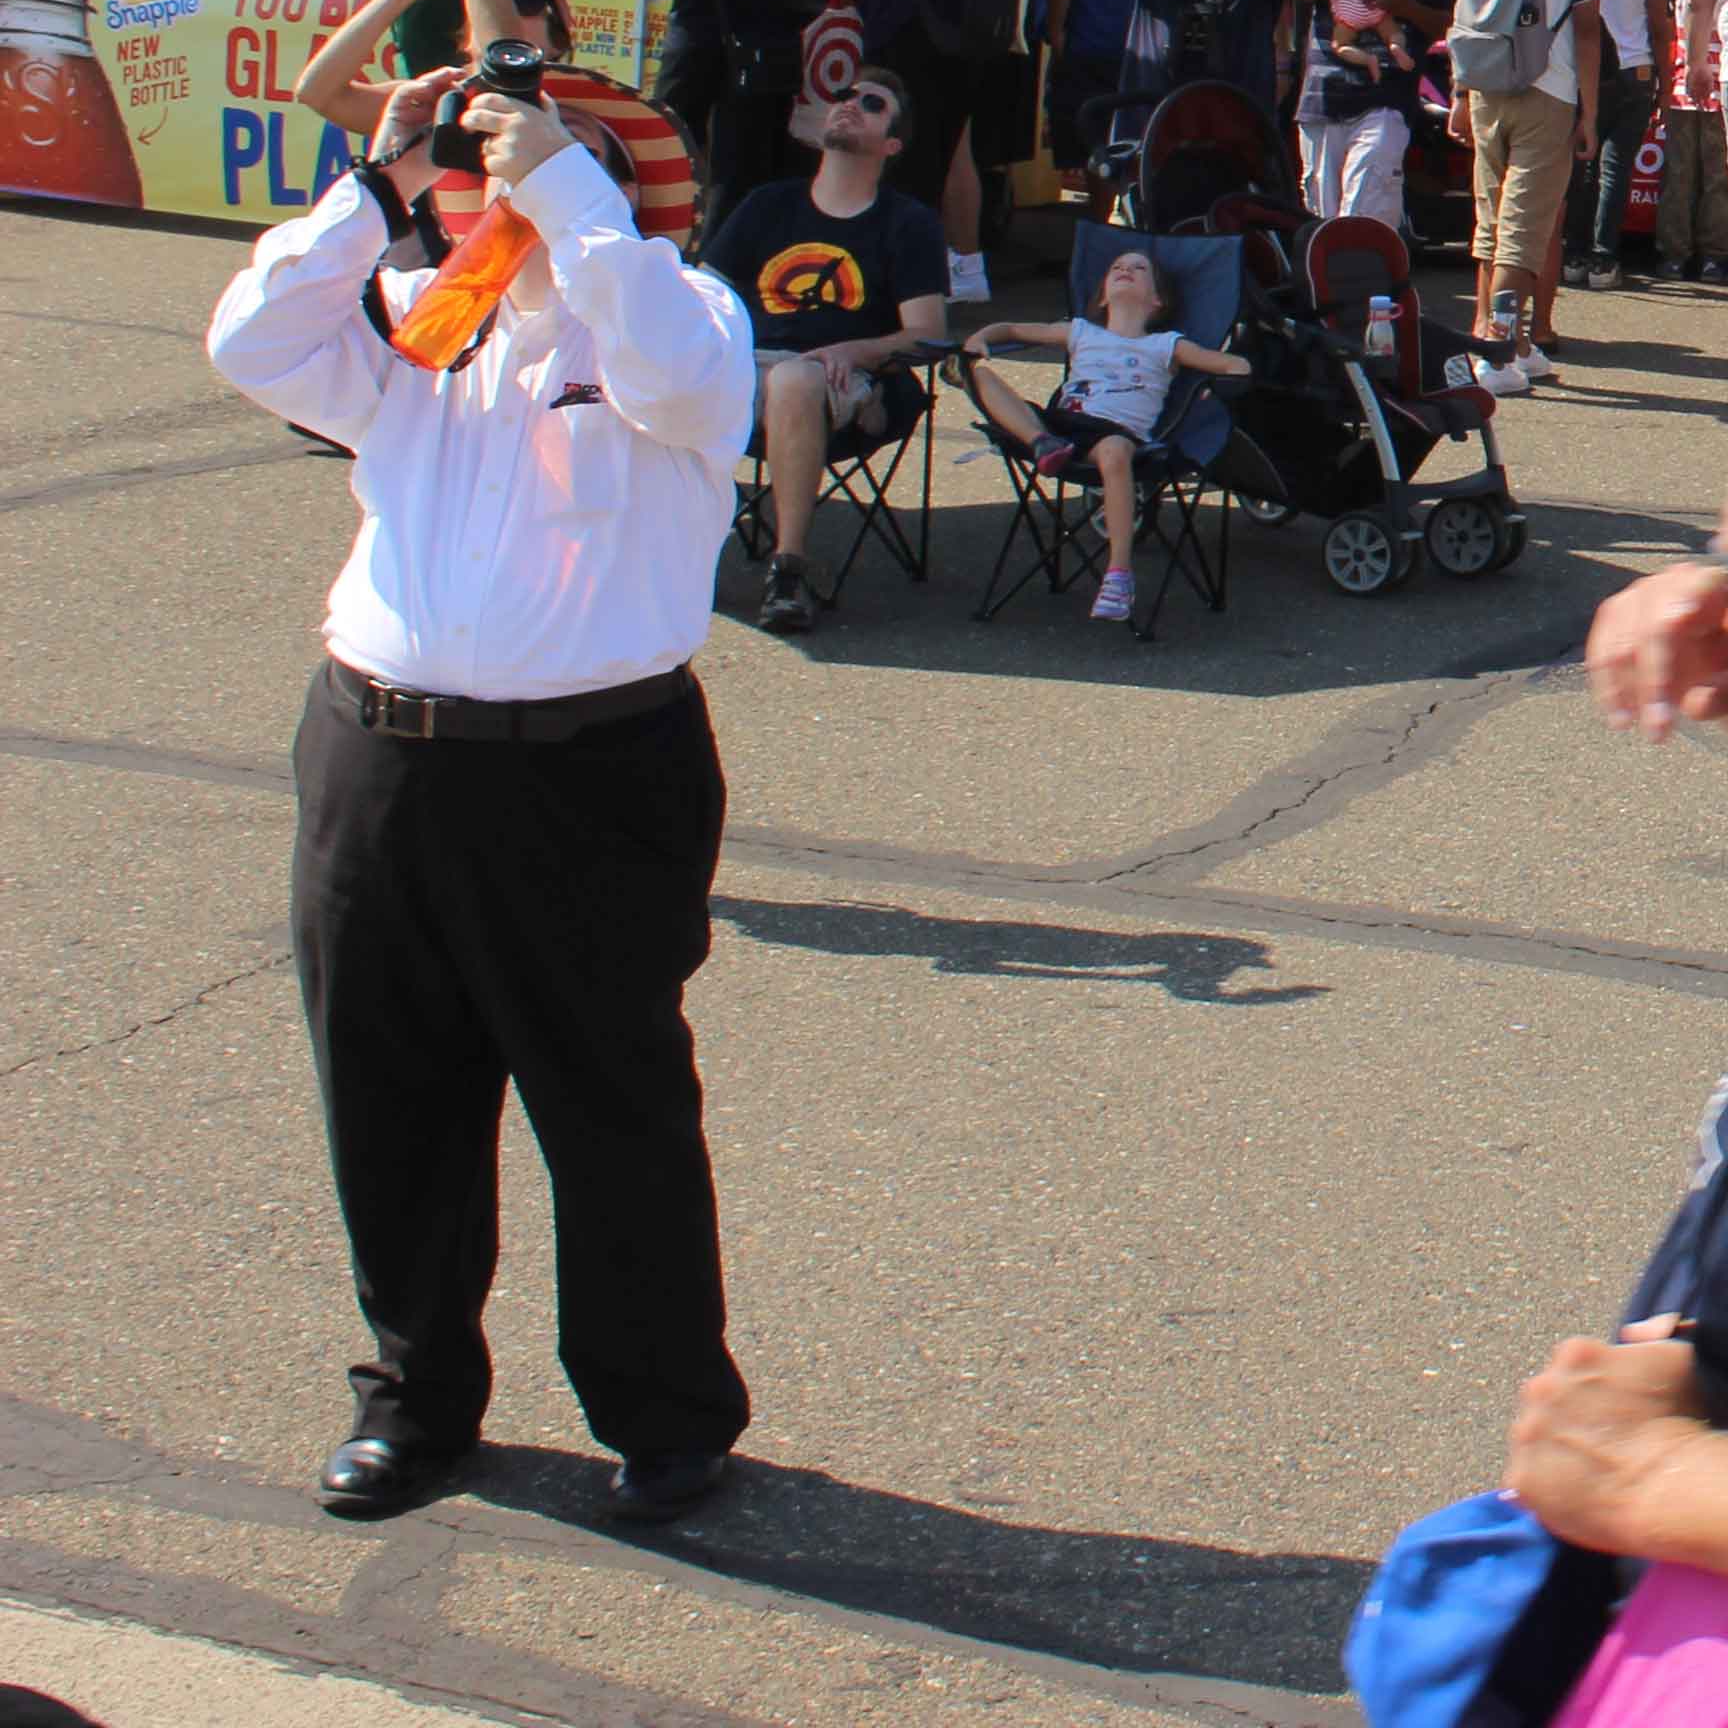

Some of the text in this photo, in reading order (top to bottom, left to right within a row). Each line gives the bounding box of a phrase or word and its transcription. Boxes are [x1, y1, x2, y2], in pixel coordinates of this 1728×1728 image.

[117, 35, 161, 62] NEW
[122, 56, 187, 85] PLASTIC
[130, 78, 190, 107] BOTTLE
